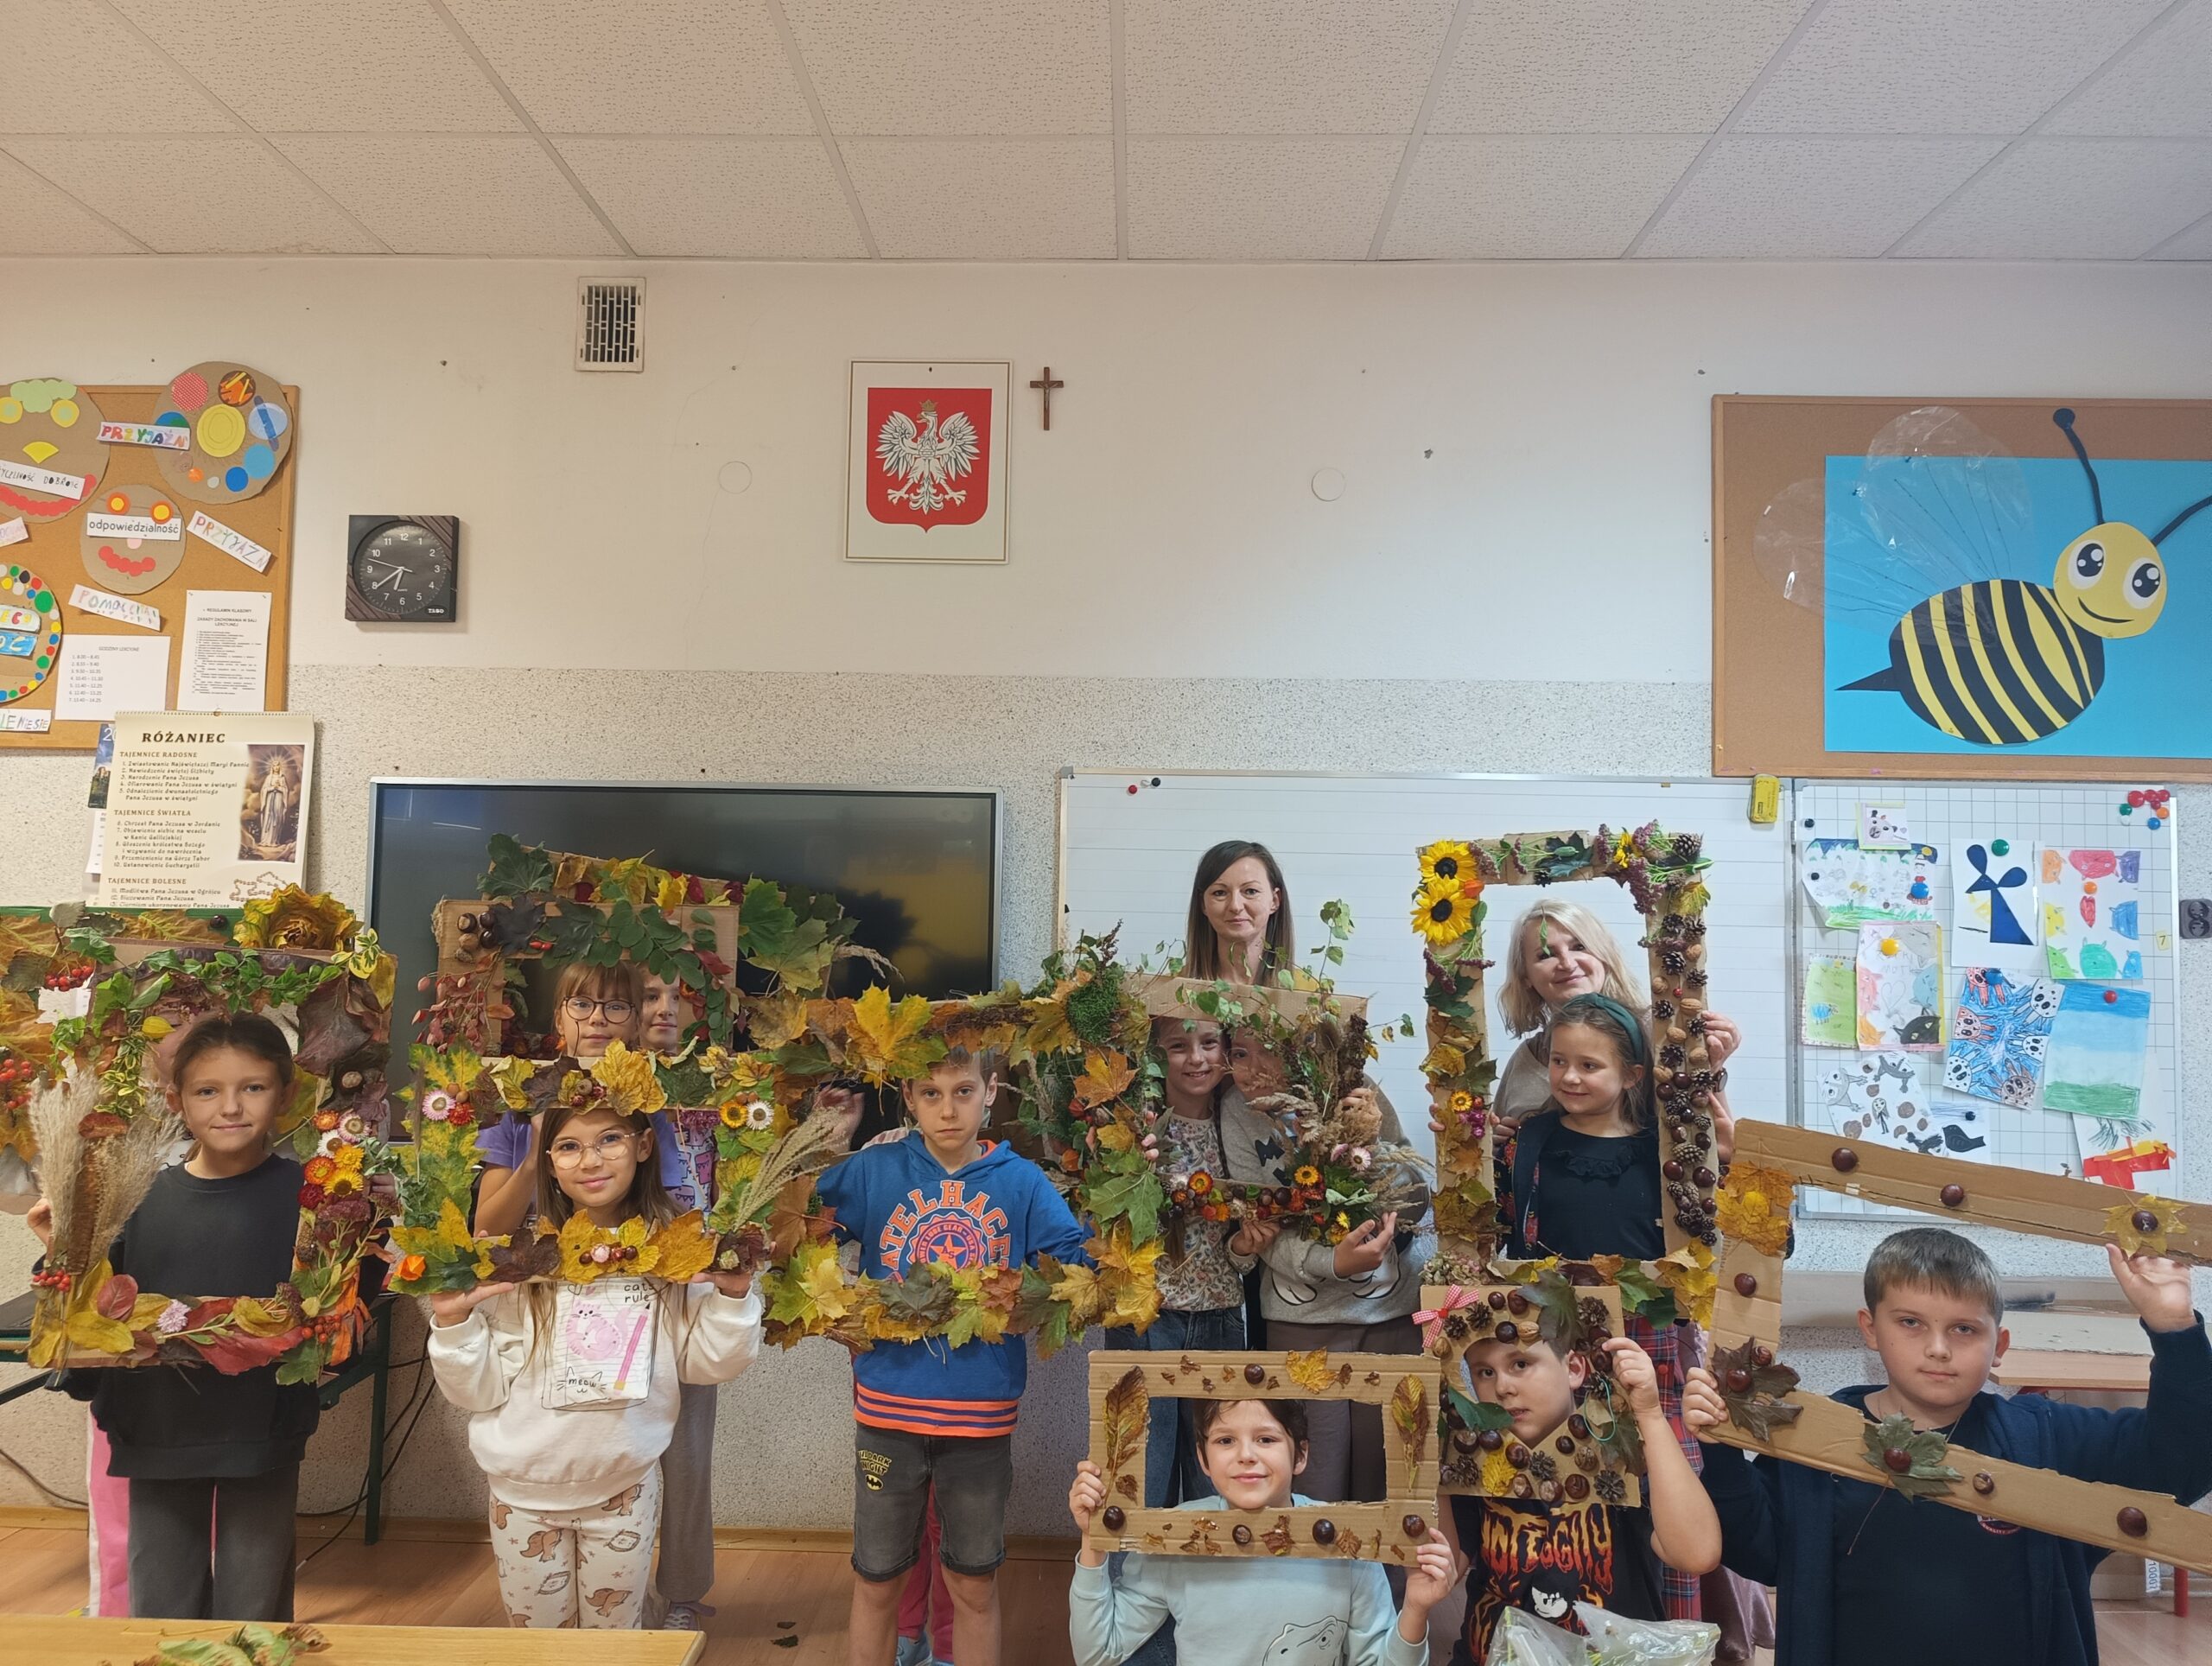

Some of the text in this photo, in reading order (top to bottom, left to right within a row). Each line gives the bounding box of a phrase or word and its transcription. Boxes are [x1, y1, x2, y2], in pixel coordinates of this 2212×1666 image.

[89, 520, 179, 534] odpowiedzialność
[142, 731, 226, 743] RÓŻANIEC
[624, 1283, 654, 1292] cats
[625, 1292, 649, 1303] rule
[569, 1378, 596, 1388] meow
